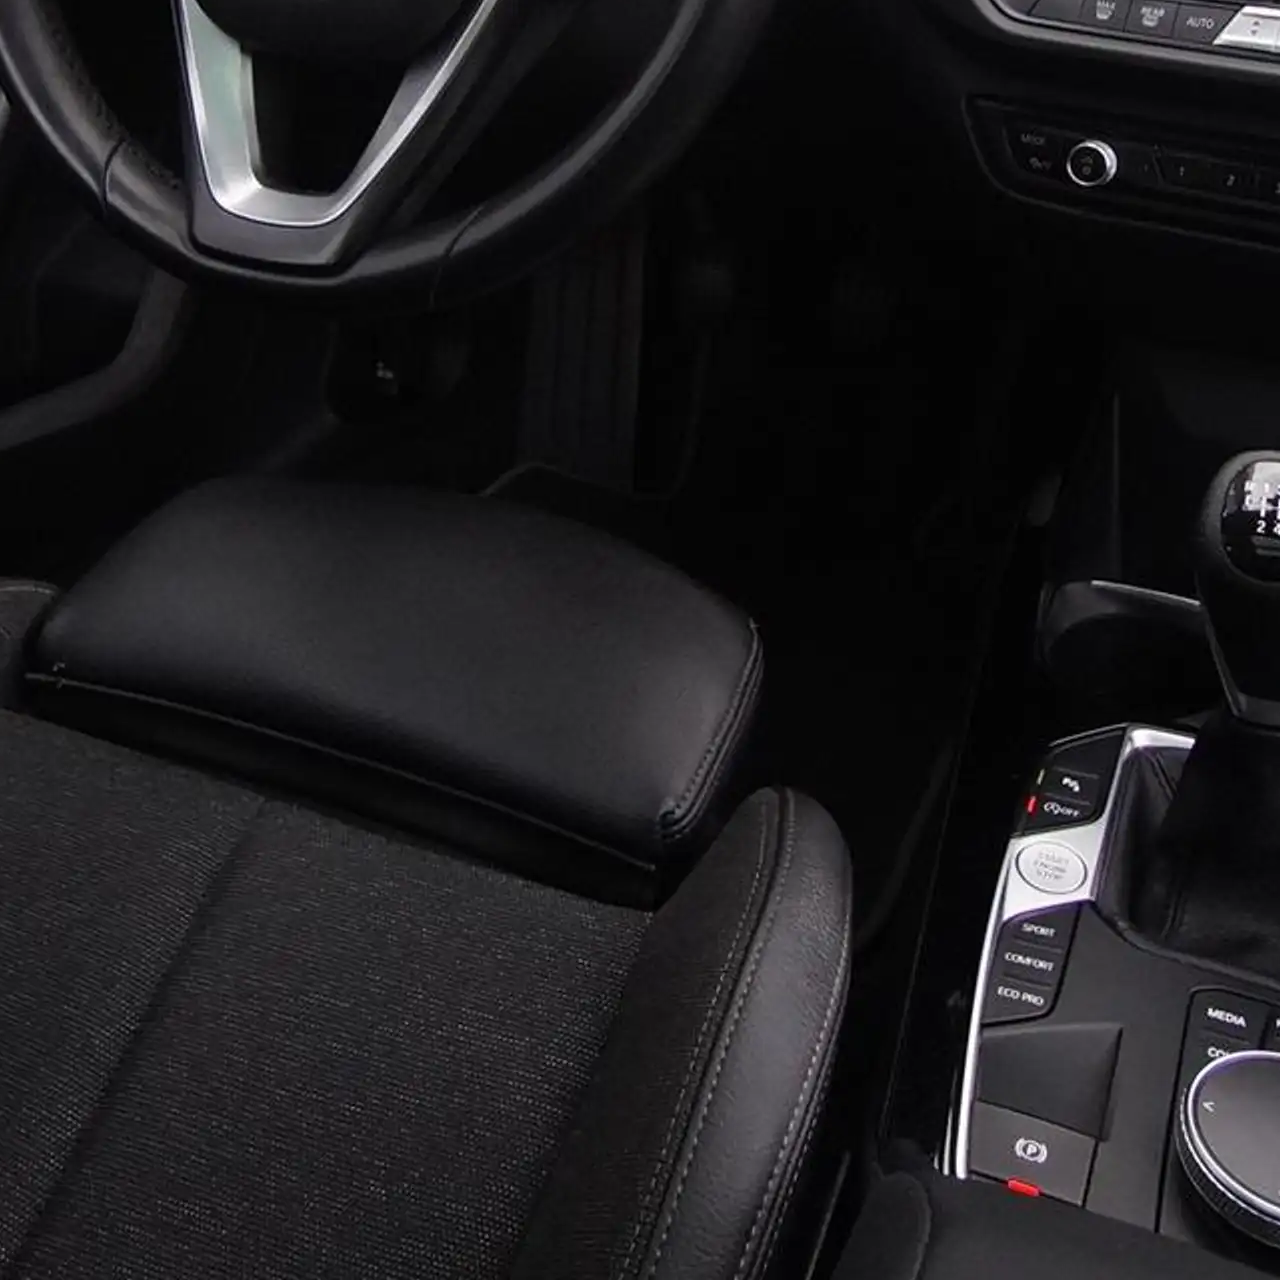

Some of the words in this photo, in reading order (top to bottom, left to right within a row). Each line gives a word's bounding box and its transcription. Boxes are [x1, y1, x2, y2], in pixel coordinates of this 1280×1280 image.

[1186, 17, 1215, 29] AUTO
[1256, 520, 1266, 533] 2
[1022, 923, 1057, 938] SPORT
[1004, 952, 1055, 972] COMFORT
[997, 986, 1020, 1000] ECO
[1022, 993, 1045, 1007] PRO
[1207, 1007, 1248, 1028] MEDIA
